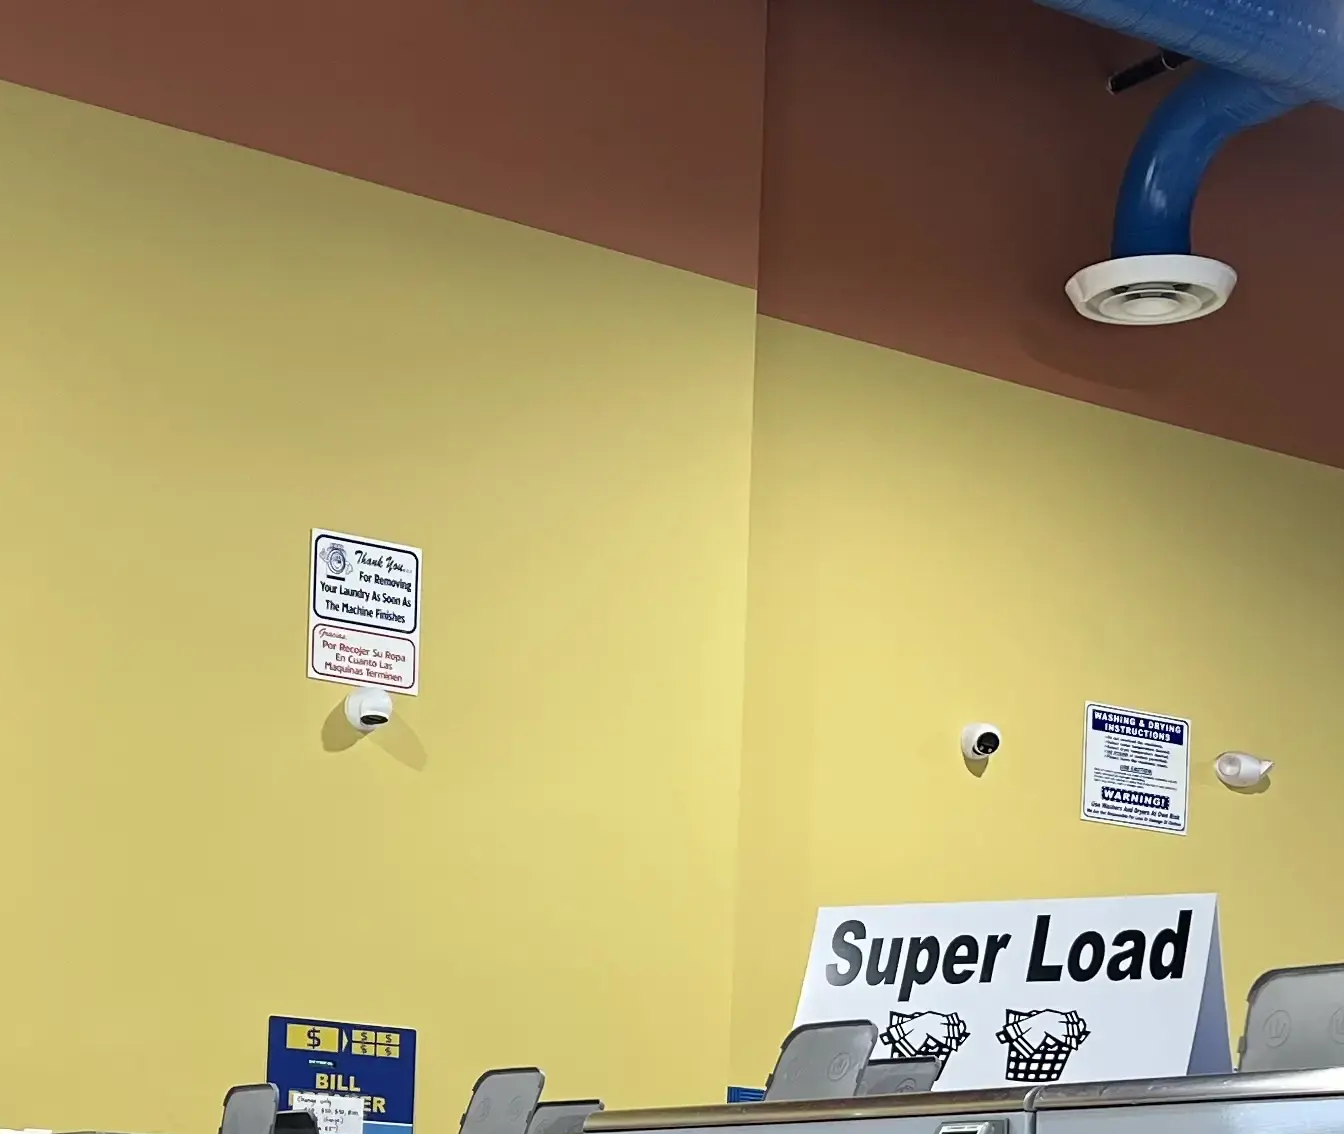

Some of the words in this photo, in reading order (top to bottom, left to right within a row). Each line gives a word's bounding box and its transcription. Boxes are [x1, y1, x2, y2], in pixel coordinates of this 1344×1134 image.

[355, 550, 384, 568] Thank
[359, 571, 372, 583] For
[374, 574, 412, 592] Removing
[320, 581, 338, 594] Your
[340, 586, 370, 602] Laundry
[371, 590, 381, 602] As
[382, 593, 401, 605] Soon
[402, 596, 412, 607] As
[325, 600, 340, 612] The
[342, 602, 374, 618] Machine
[376, 609, 406, 623] Finishes
[322, 640, 337, 650] Por
[339, 643, 370, 656] Recojer
[372, 648, 383, 658] Su
[385, 652, 406, 663] Ropa
[335, 653, 346, 662] En
[348, 656, 377, 667] Cuanto
[379, 661, 393, 670] Las
[366, 669, 402, 682] Terminen
[1094, 711, 1136, 725] WASHING
[1138, 719, 1145, 727] &
[1148, 720, 1182, 734] DRYING
[1104, 723, 1171, 741] INSTRUCTIONS
[1103, 789, 1165, 807] WARNING!
[825, 919, 1011, 1001] Super
[1026, 909, 1193, 983] Load
[315, 1072, 361, 1092] BILL
